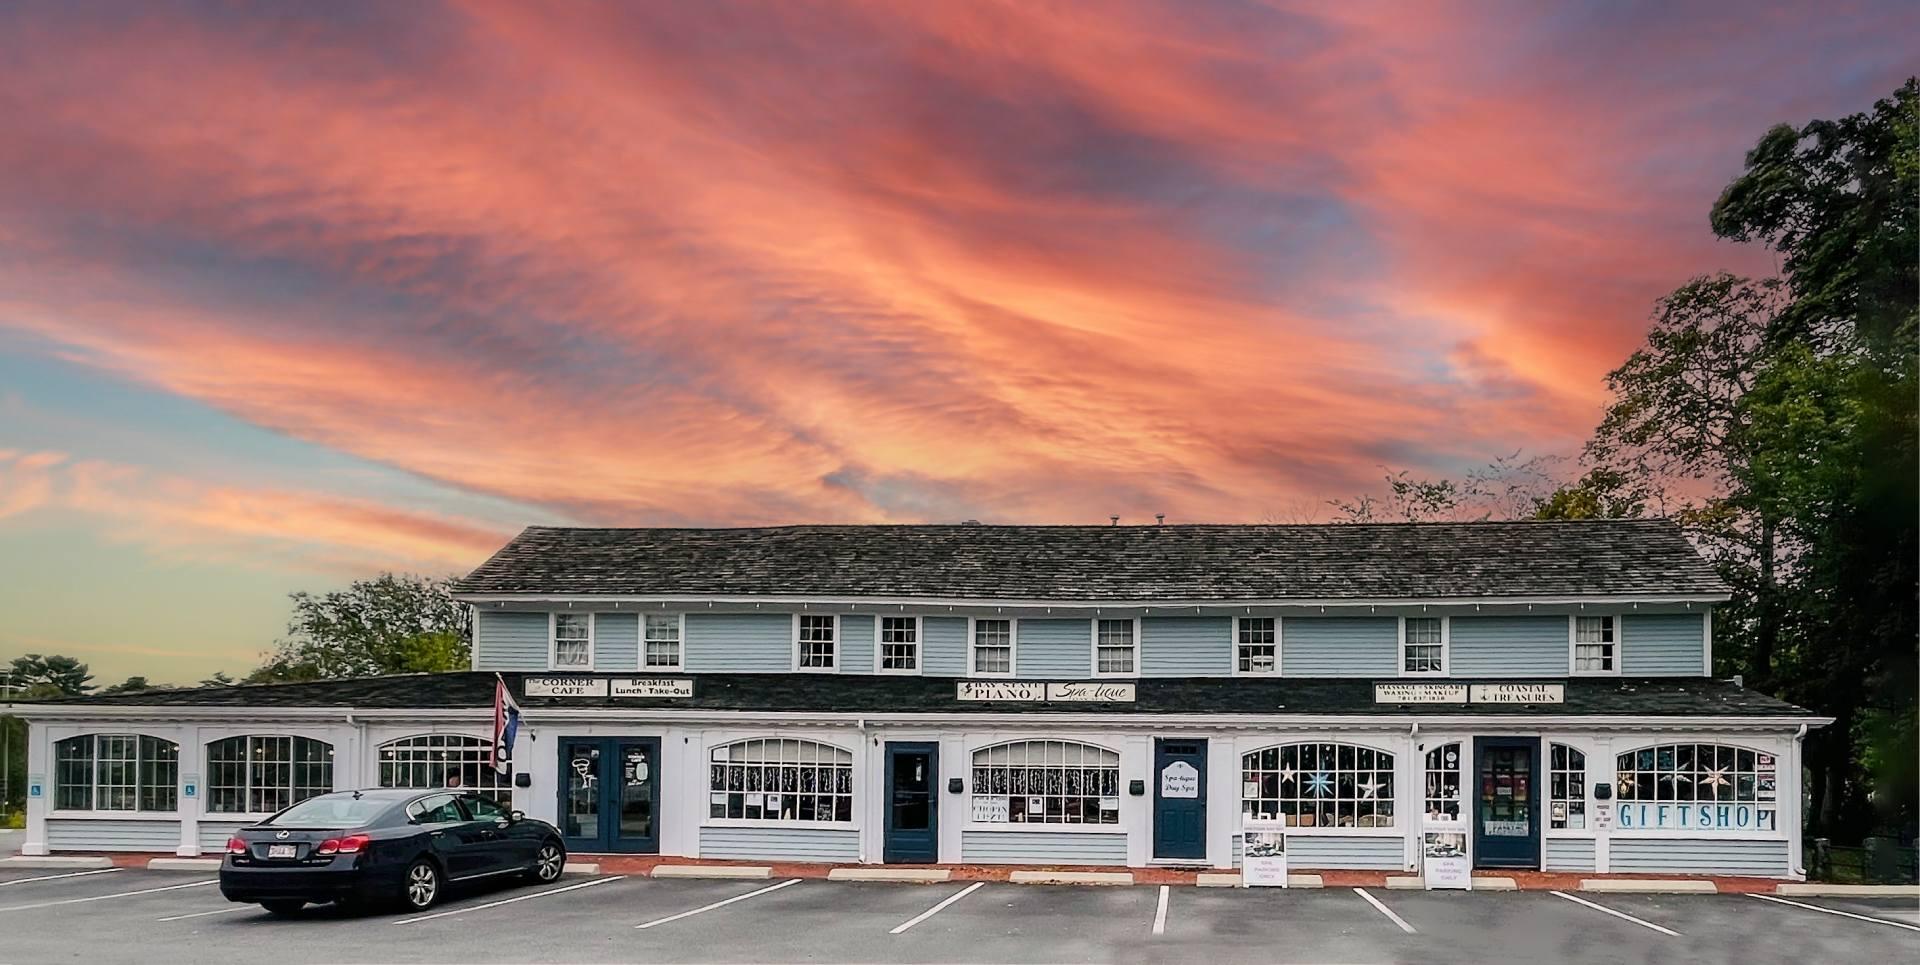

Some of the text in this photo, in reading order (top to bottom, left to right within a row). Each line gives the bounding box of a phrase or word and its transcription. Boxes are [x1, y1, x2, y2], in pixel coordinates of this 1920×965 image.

[1499, 684, 1548, 693] COASTAL
[974, 689, 1031, 699] PIANO
[1494, 693, 1555, 702] TREASURES
[1181, 783, 1195, 793] Spa
